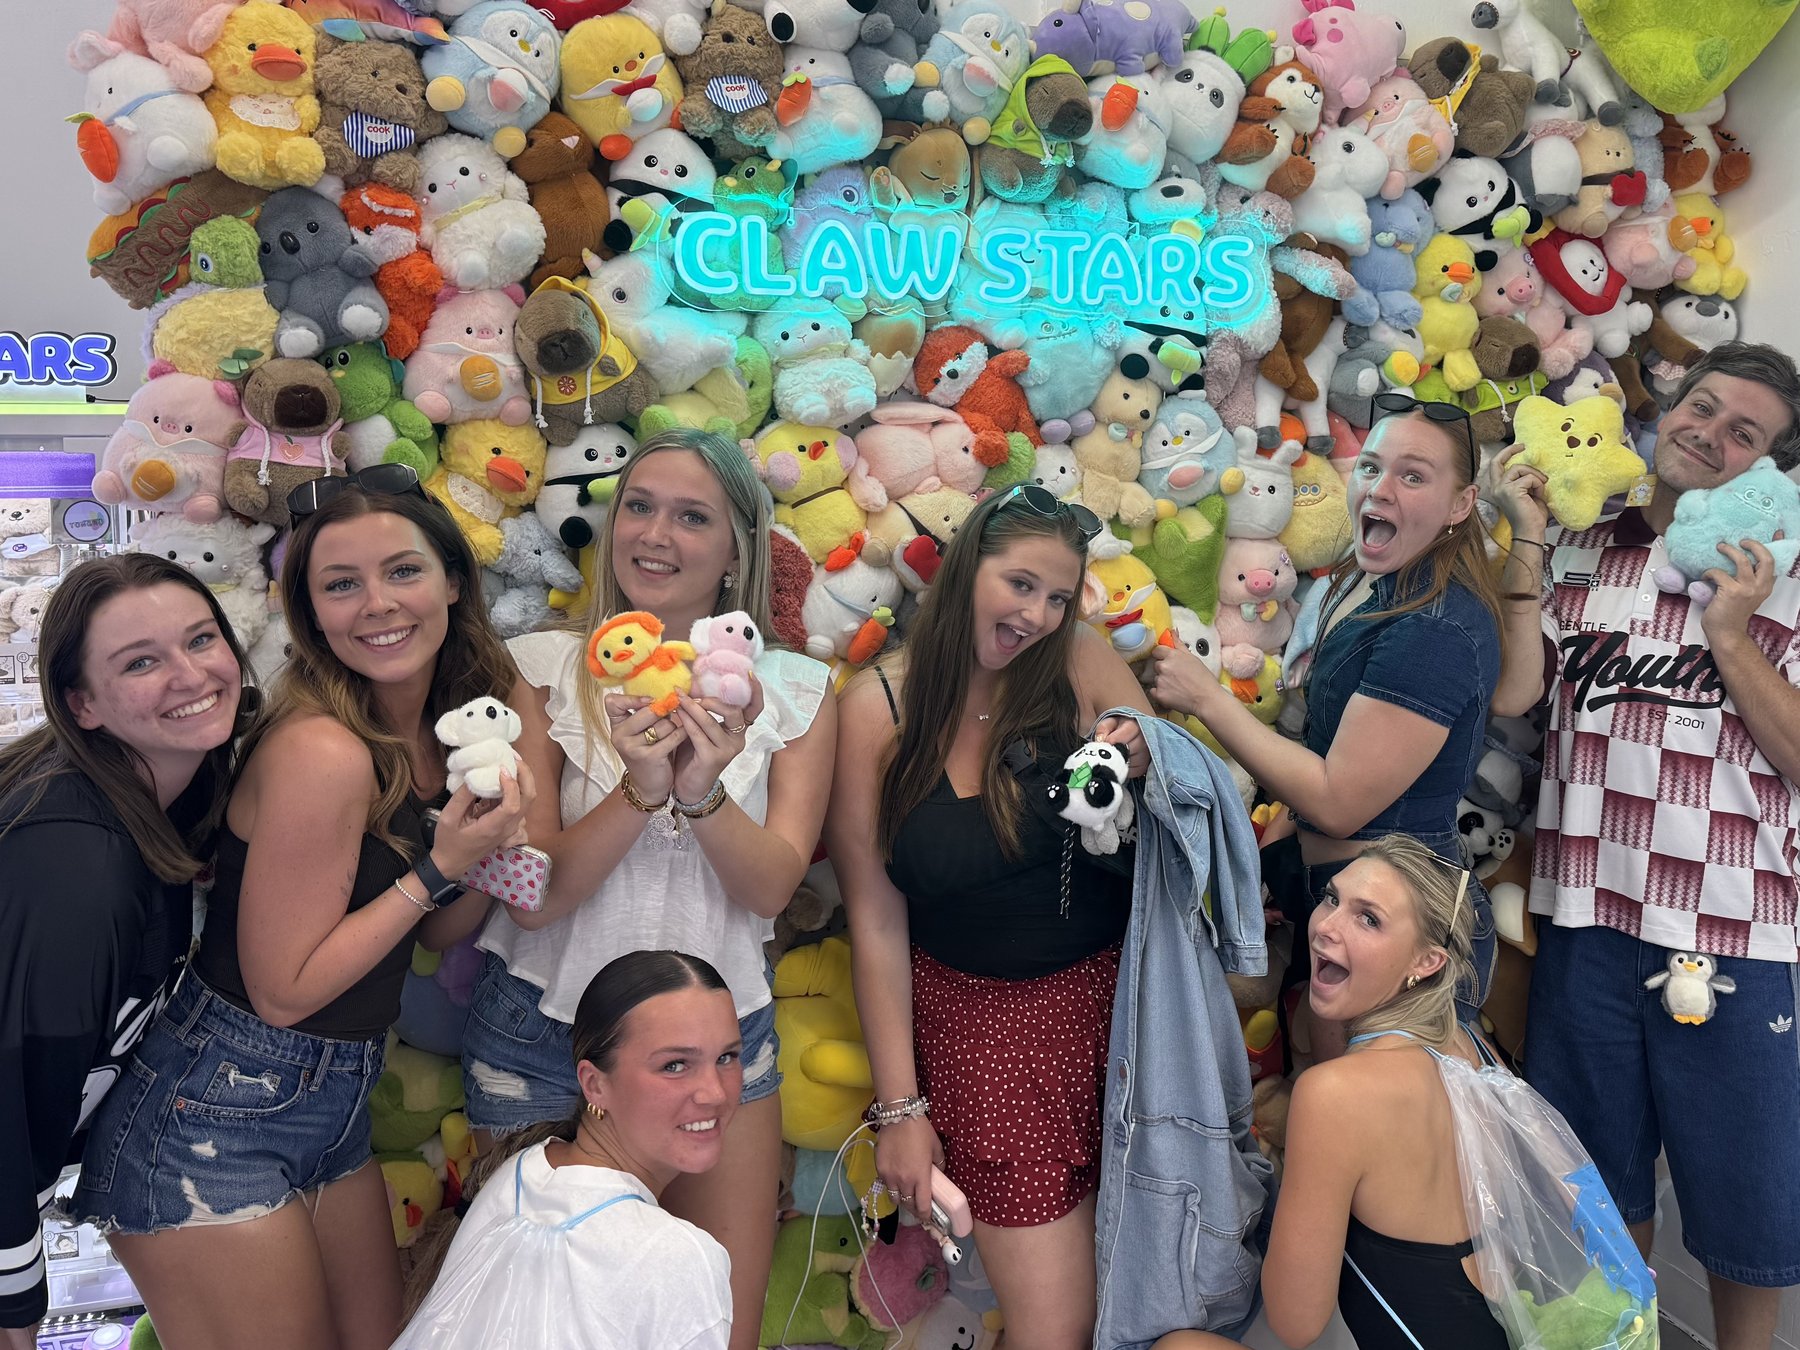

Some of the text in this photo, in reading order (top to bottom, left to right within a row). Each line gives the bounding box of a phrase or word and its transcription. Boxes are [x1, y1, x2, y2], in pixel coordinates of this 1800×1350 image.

[673, 211, 1256, 309] CLAW STARS
[1559, 620, 1608, 632] GENTLE
[1559, 630, 1726, 713] Youth
[1647, 708, 1705, 730] EST. 2001
